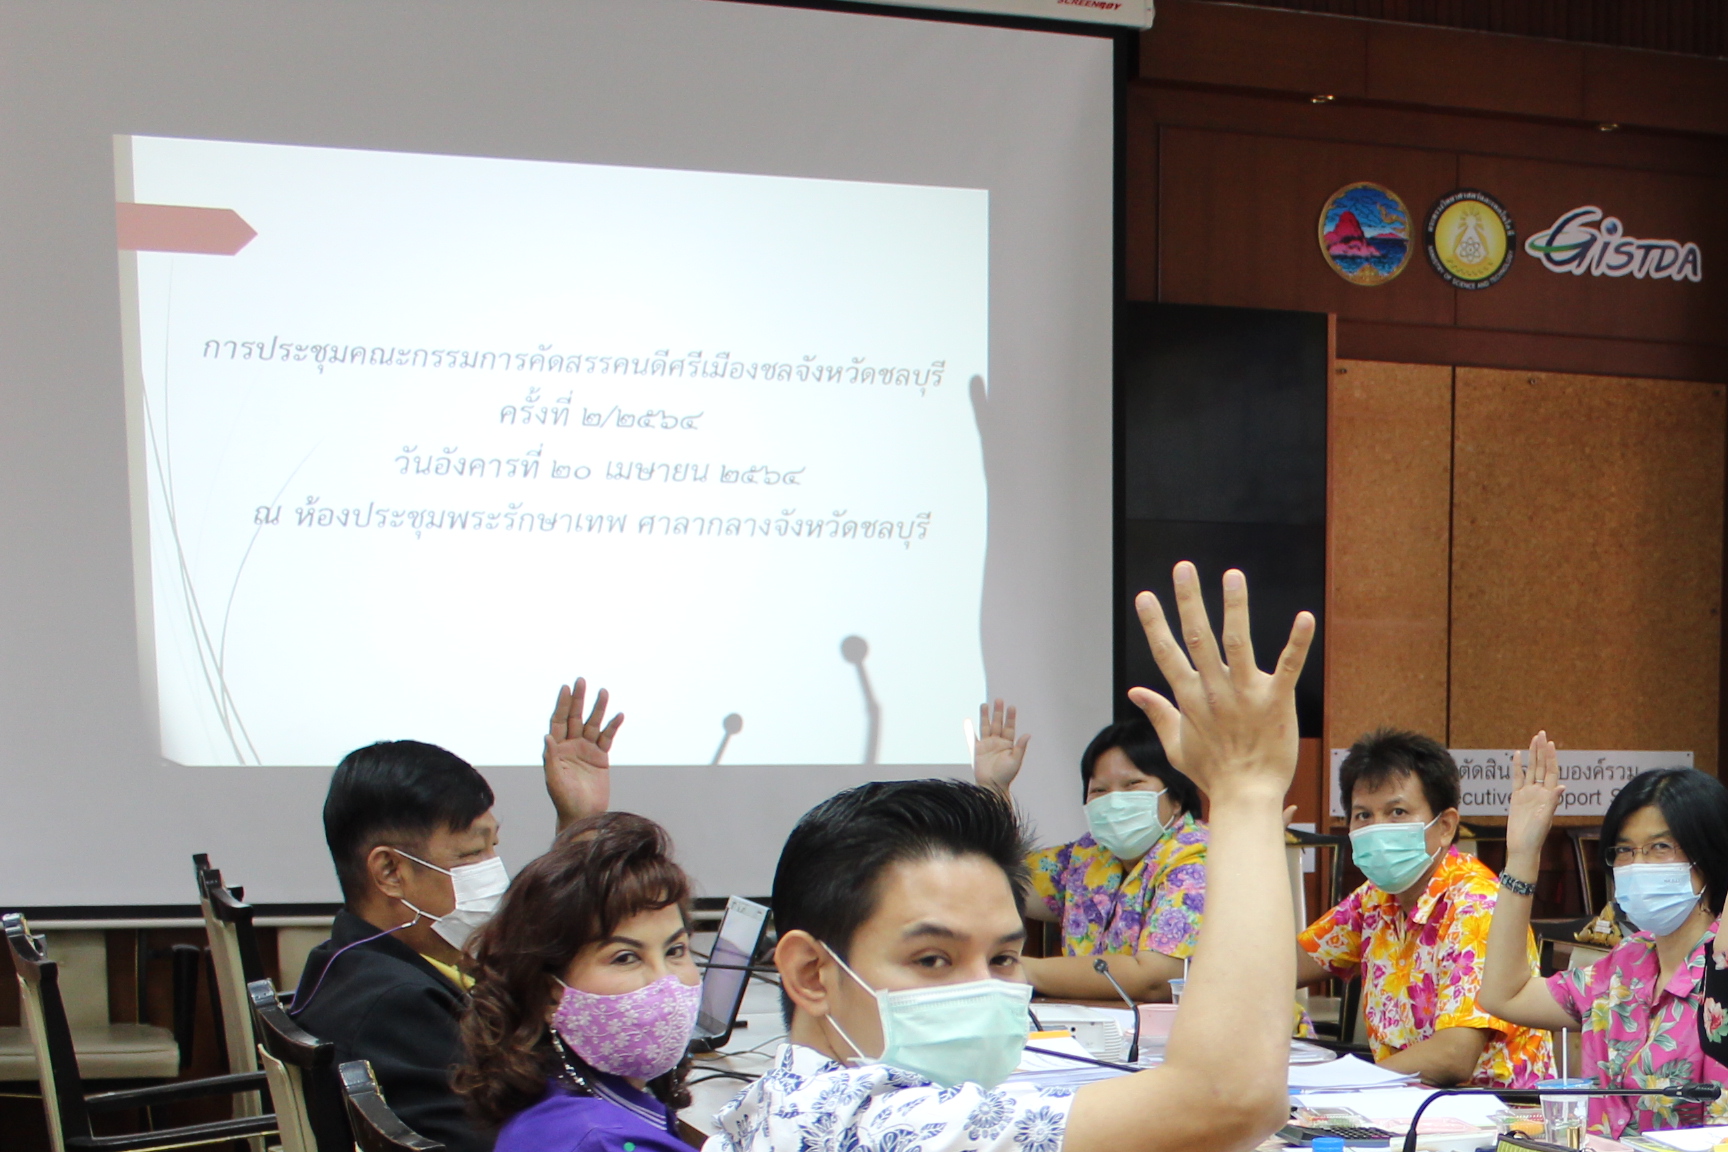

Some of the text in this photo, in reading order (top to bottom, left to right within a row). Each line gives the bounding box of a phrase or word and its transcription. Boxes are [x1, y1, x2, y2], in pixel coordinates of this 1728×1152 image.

[500, 386, 704, 430] ครั้งที่ ๒/๒๕๖๔
[395, 443, 806, 485] วันอังคารที่ ๒๐ เมษายน ๒๕๖๔
[253, 504, 282, 526] ณ
[638, 508, 932, 550] ศาลากลางจังหวัดชลบุรี
